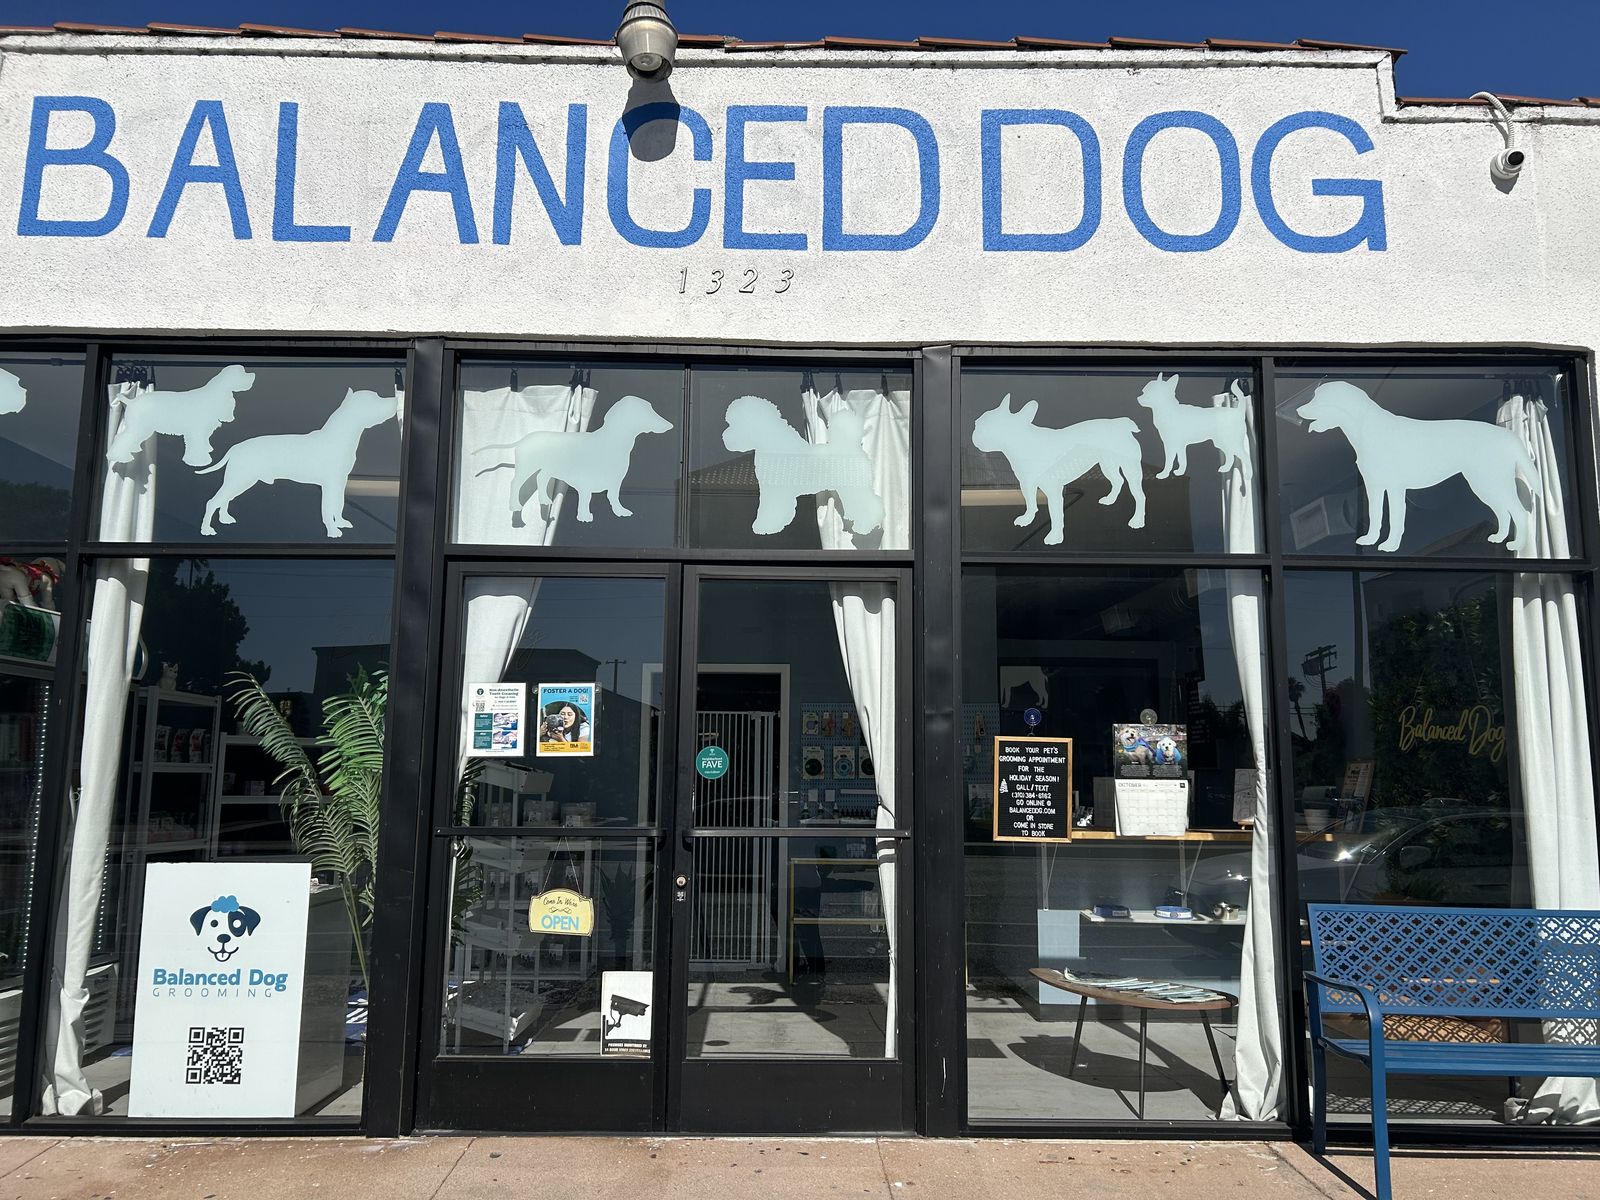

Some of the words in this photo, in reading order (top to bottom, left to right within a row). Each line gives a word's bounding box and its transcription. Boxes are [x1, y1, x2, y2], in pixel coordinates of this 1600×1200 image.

[17, 95, 940, 252] BALANCED
[981, 109, 1388, 253] DOG
[678, 267, 795, 294] 1323
[1398, 705, 1468, 751] Balanced
[1468, 705, 1505, 762] Dog
[702, 761, 723, 769] FAVE
[999, 755, 1026, 763] GROOMING
[1028, 756, 1066, 764] APPOINTMENT
[543, 896, 556, 906] Come
[556, 896, 563, 905] In
[541, 914, 580, 931] OPEN
[152, 968, 241, 986] Balanced
[248, 968, 289, 992] Dog
[152, 987, 272, 998] GROOMING
